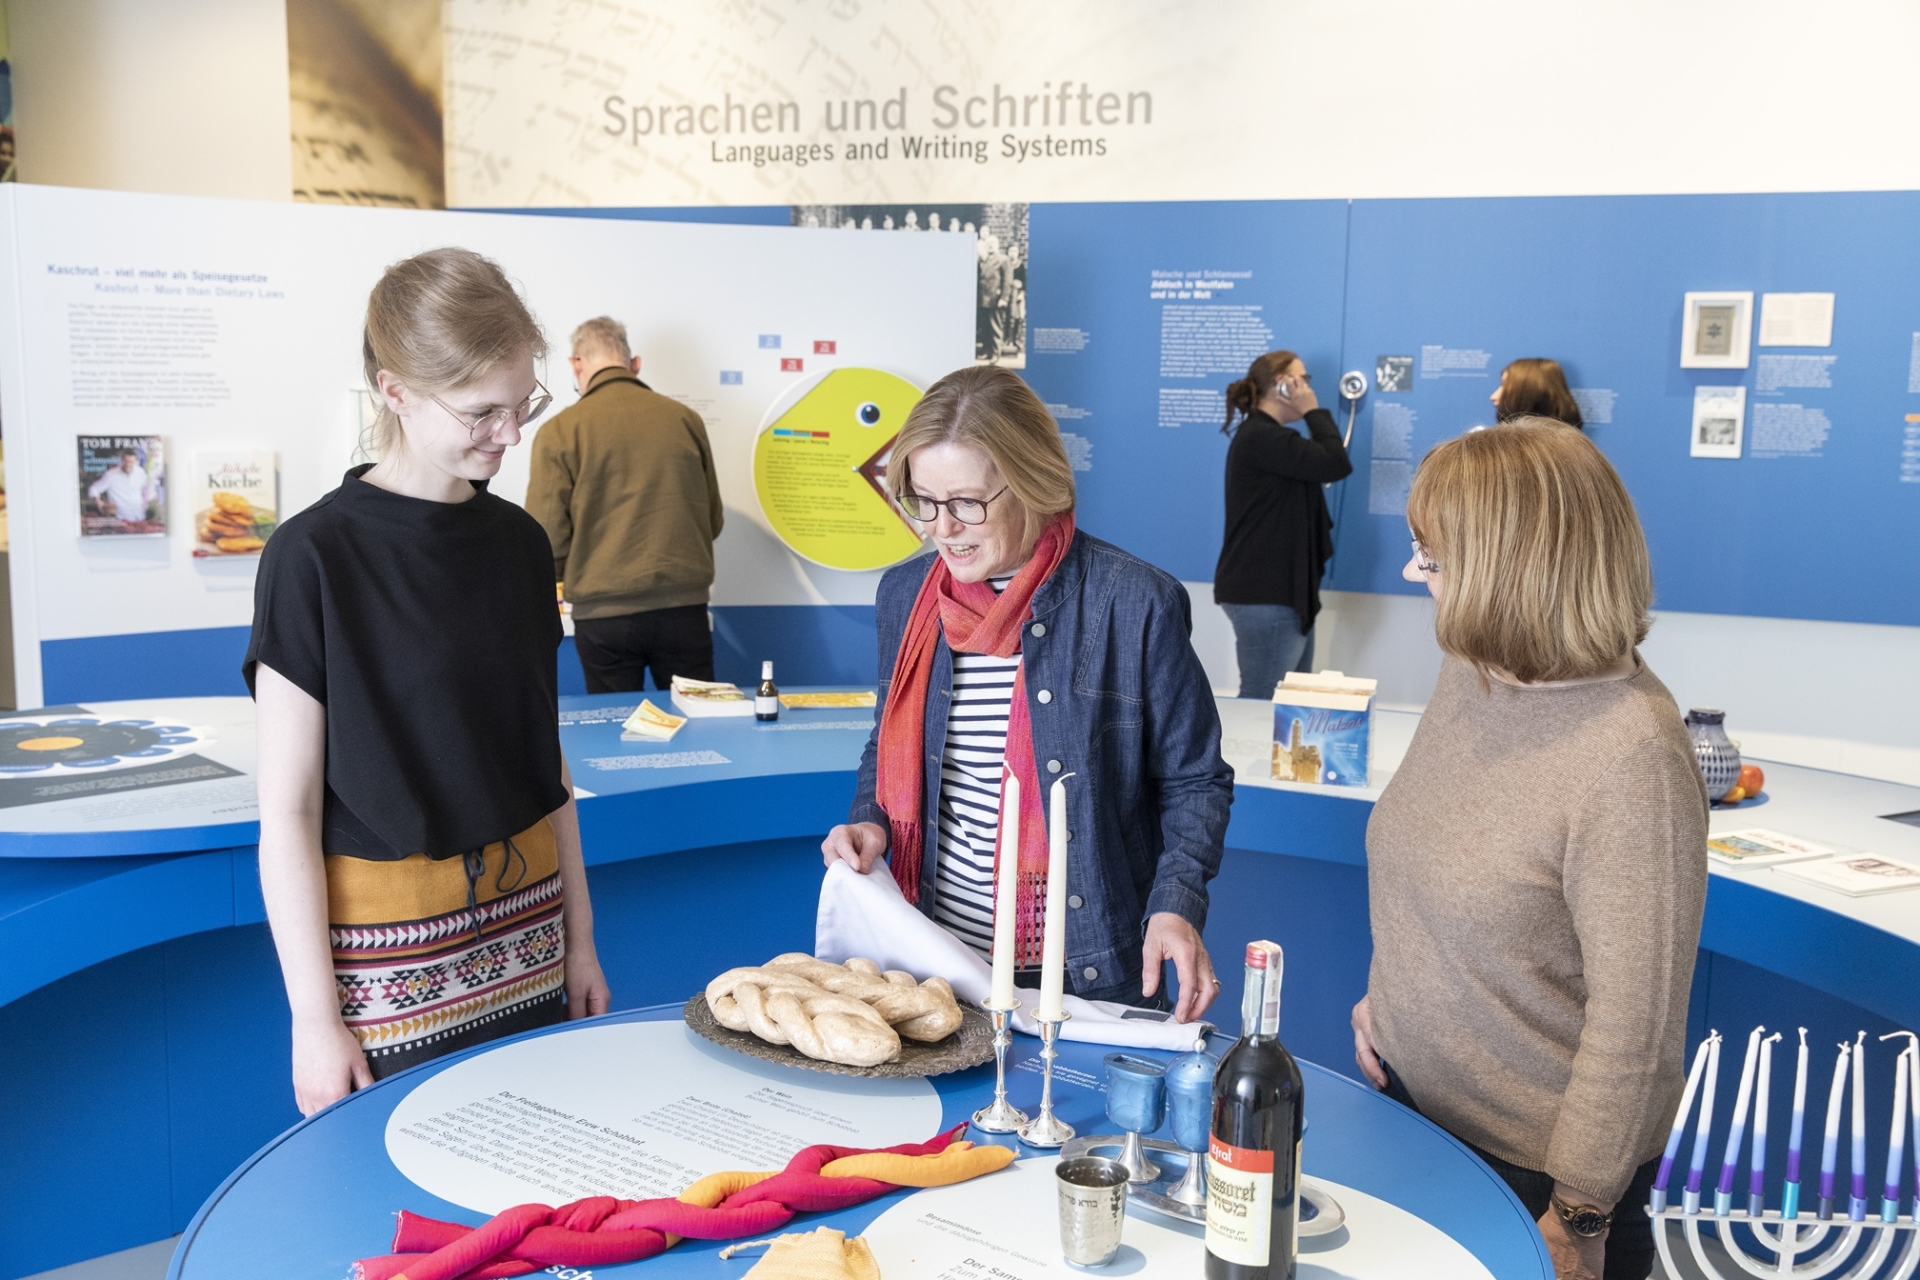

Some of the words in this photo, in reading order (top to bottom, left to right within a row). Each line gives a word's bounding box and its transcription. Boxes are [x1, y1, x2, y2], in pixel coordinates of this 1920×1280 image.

[603, 93, 800, 146] Sprachen
[825, 87, 907, 132] und
[932, 81, 1153, 129] Schriften
[711, 140, 834, 167] Languages
[845, 137, 888, 161] and
[901, 134, 988, 163] Writing
[1001, 133, 1107, 161] Systems
[48, 264, 99, 277] Kaschrut
[115, 268, 135, 278] viel
[139, 268, 168, 280] mehr
[172, 269, 187, 280] als
[192, 270, 268, 285] Speisegesetze
[1151, 280, 1183, 289] Jiddisch
[1185, 280, 1193, 289] in
[1195, 280, 1234, 289] Westfalen
[1185, 270, 1201, 279] und
[95, 281, 139, 295] Kashrut
[155, 284, 182, 296] More
[186, 285, 212, 297] than
[215, 286, 254, 300] Dietary
[258, 287, 285, 299] Laws
[1150, 290, 1166, 299] und
[1168, 290, 1176, 299] in
[1178, 290, 1191, 299] der
[1193, 290, 1212, 299] Welt
[80, 437, 111, 449] TOM
[208, 473, 262, 488] Küche
[1306, 711, 1363, 734] Matzos
[498, 1090, 516, 1099] Der
[515, 1097, 574, 1120] Freitagabend:
[575, 1118, 599, 1129] Erew
[599, 1127, 645, 1145] Schabbat
[456, 1106, 488, 1119] zündet
[486, 1117, 502, 1125] die
[502, 1122, 533, 1136] Mutter
[549, 1140, 582, 1154] Kerzen
[596, 1158, 619, 1168] und
[616, 1166, 652, 1180] segnet
[650, 1178, 668, 1188] sie.
[468, 1101, 515, 1119] gedeckten
[515, 1116, 540, 1129] Tisch.
[543, 1127, 561, 1136] Oft
[559, 1134, 583, 1143] sind
[581, 1140, 619, 1157] Freunde
[620, 1156, 672, 1178] eingeladen.
[483, 1096, 501, 1104] Am
[501, 1101, 559, 1124] Freitagabend
[557, 1122, 611, 1143] versammelt
[609, 1141, 631, 1151] sich
[630, 1149, 648, 1157] die
[648, 1154, 684, 1170] Familie
[684, 1168, 702, 1177] am
[427, 1116, 454, 1128] deren
[453, 1125, 486, 1141] Spruch.
[488, 1139, 514, 1151] Dann
[513, 1149, 548, 1164] spricht
[558, 1166, 579, 1176] den
[579, 1173, 625, 1193] Kiddusch
[442, 1111, 473, 1124] segnet
[471, 1122, 488, 1130] die
[487, 1127, 518, 1141] Kinder
[517, 1139, 540, 1149] und
[537, 1147, 566, 1159] dankt
[564, 1157, 595, 1170] seiner
[595, 1167, 619, 1180] Frau
[618, 1177, 639, 1187] mit
[1211, 1143, 1233, 1163] Efrat
[1078, 1199, 1098, 1208] בורא
[925, 1212, 981, 1235] Besamimdose
[949, 1265, 979, 1280] Zum
[963, 1257, 986, 1270] Der
